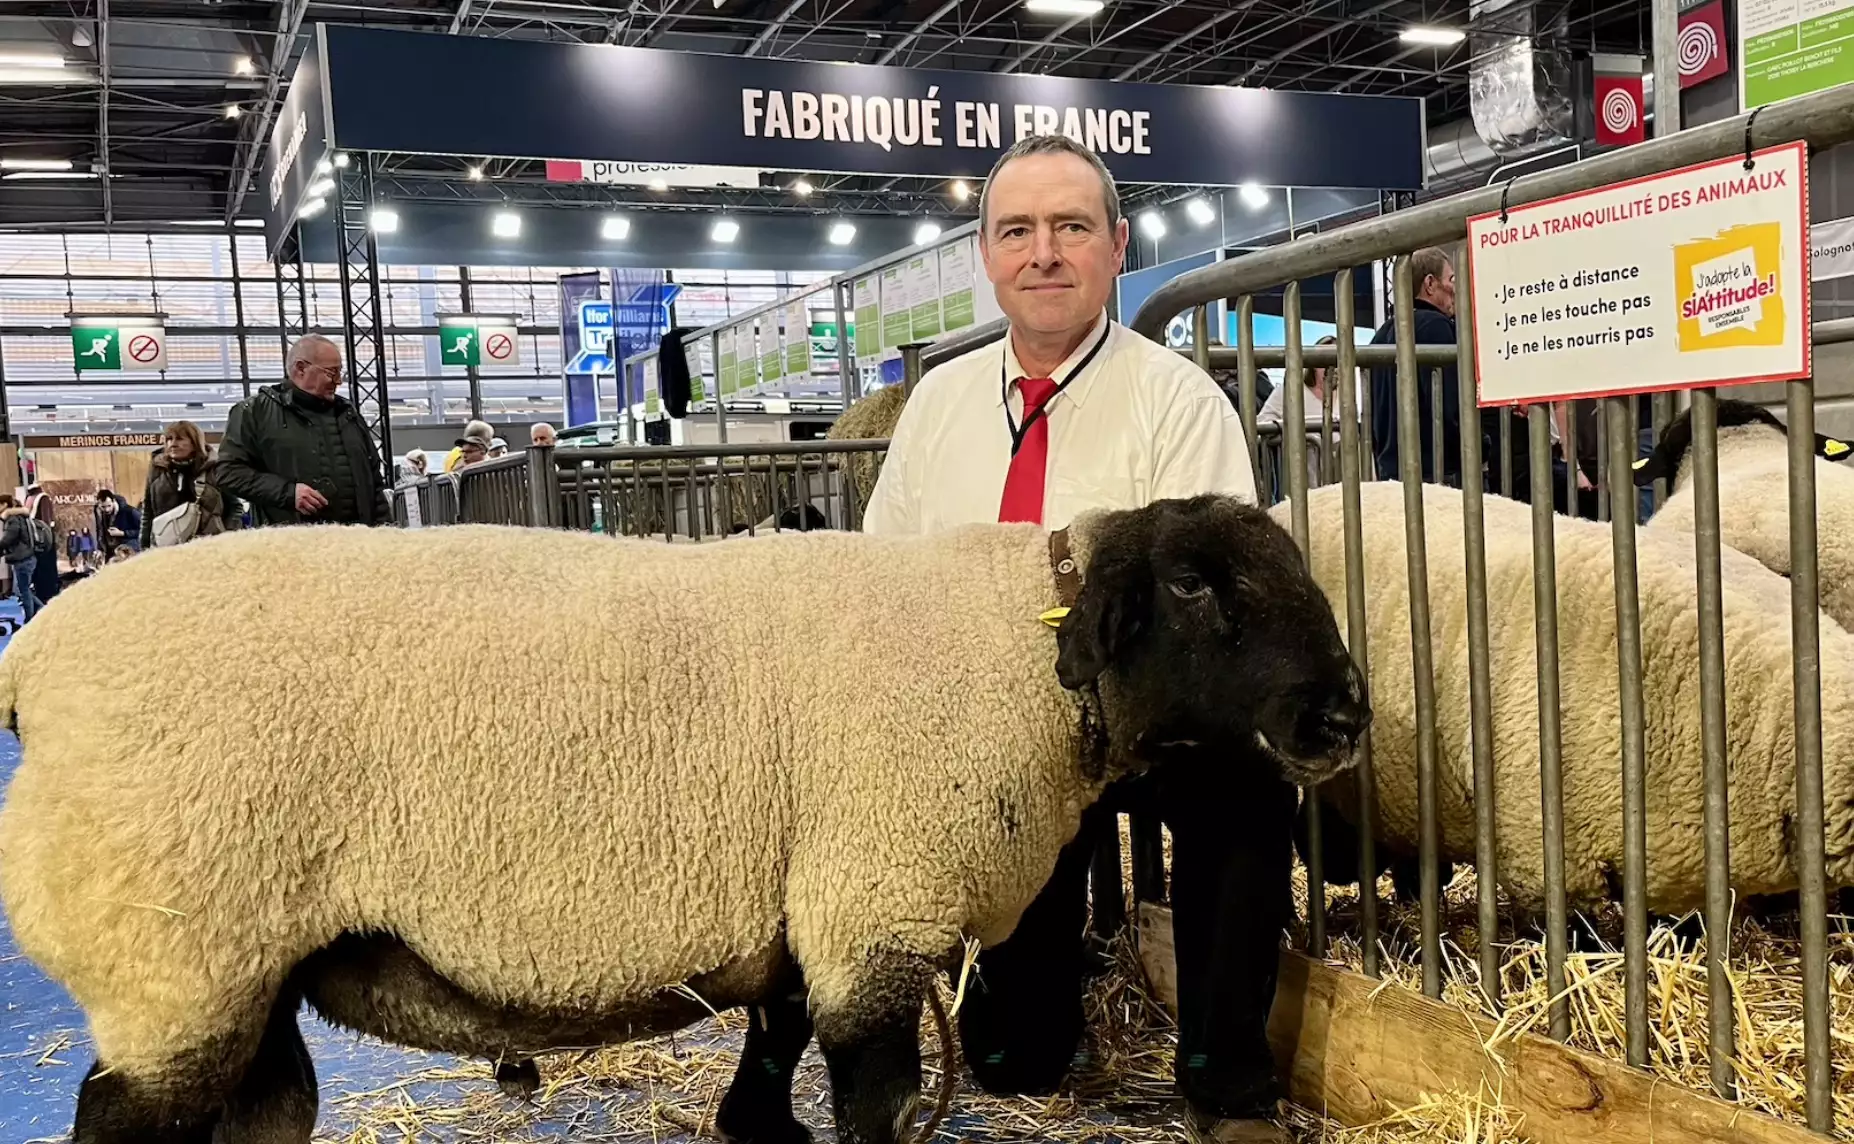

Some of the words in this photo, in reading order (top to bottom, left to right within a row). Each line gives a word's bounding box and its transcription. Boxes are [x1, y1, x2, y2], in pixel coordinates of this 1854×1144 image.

[742, 85, 943, 152] FABRIQUÉ
[955, 101, 1000, 149] EN
[1014, 104, 1151, 154] FRANCE
[1481, 228, 1518, 249] POUR
[1522, 223, 1540, 240] LA
[1543, 193, 1653, 236] TRANQUILLITÉ
[1658, 190, 1691, 212] DES
[1696, 169, 1787, 204] ANIMAUX
[1502, 284, 1516, 304] Je
[1519, 279, 1555, 297] reste
[1559, 274, 1569, 290] à
[1572, 266, 1639, 288] distance
[1697, 265, 1740, 288] J'adopte
[1742, 261, 1752, 277] la
[1503, 312, 1517, 332] Je
[1521, 312, 1537, 325] ne
[1541, 306, 1561, 322] les
[1565, 297, 1617, 319] touche
[1622, 295, 1651, 315] pas
[1708, 305, 1751, 323] RESPONSABLES
[1715, 315, 1744, 328] ENSEMBLE
[1505, 340, 1519, 360] Je
[1522, 341, 1539, 354] ne
[1543, 335, 1563, 351] les
[1567, 327, 1621, 349] nourris
[1625, 326, 1654, 346] pas
[60, 436, 111, 447] MERINOS
[114, 435, 156, 446] FRANCE
